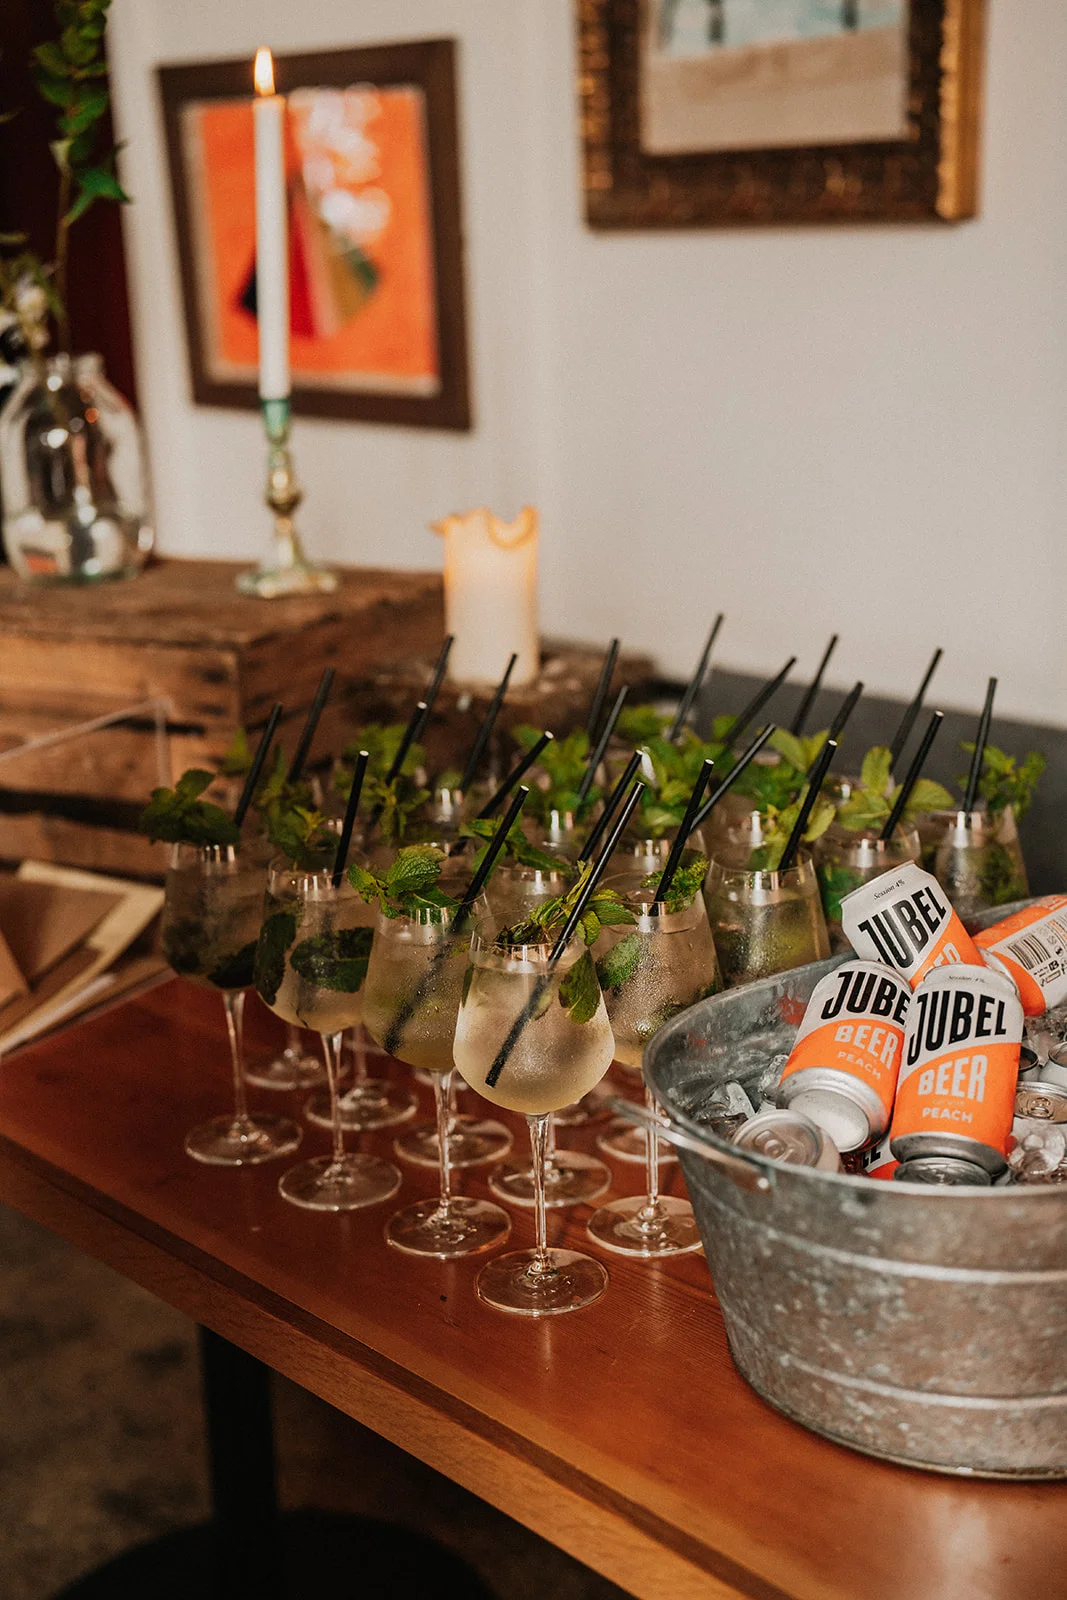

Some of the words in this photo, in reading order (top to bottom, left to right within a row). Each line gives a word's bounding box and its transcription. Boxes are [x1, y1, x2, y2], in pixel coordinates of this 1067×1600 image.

[857, 886, 947, 970] JUBEL
[820, 971, 911, 1026] JUBE
[834, 1025, 899, 1071] BEER
[906, 990, 1007, 1067] JUBEL
[837, 1051, 882, 1081] PEACH
[917, 1054, 989, 1103] BEER
[922, 1107, 973, 1124] PEACH
